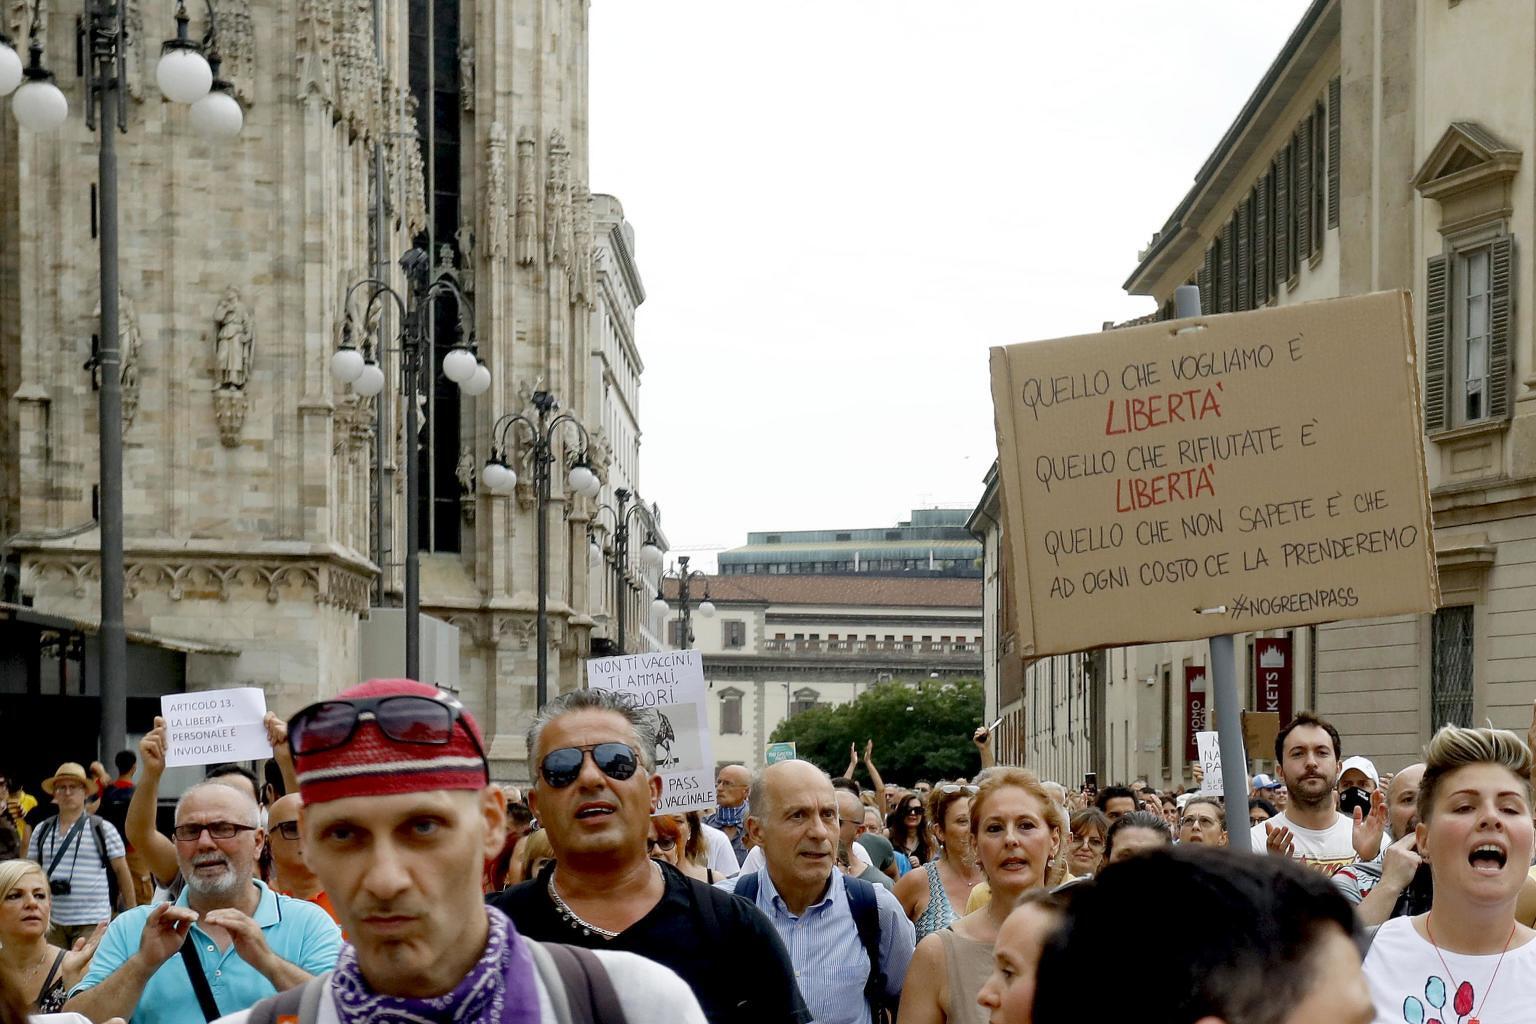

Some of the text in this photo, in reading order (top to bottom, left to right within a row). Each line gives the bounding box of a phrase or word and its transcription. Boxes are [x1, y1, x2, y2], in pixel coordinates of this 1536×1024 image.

[1022, 369, 1110, 421] QUELLO
[1121, 361, 1161, 392] CHE
[1171, 343, 1274, 381] VOGLIAMO
[1035, 449, 1116, 493] QUELLO
[1126, 445, 1168, 473] CHE
[1177, 426, 1284, 465] RIFIUTATE
[1044, 523, 1124, 567] QUELLO
[1136, 520, 1172, 546] CHE
[1182, 509, 1224, 540] NON
[1238, 498, 1315, 533] SAPETE
[1354, 489, 1389, 514] CHE
[1049, 525, 1418, 600] AD OGNI COSTO CE LA PRENDEREMO
[1230, 586, 1359, 619] #NOGREENPASS
[594, 659, 622, 674] NON
[607, 675, 621, 688] TI
[1265, 672, 1279, 711] KETS
[170, 699, 234, 713] ARTICOLO 13.
[171, 719, 183, 728] LA
[172, 729, 230, 742] PERSONALE
[174, 744, 235, 756] INVIOLABILE.
[669, 776, 699, 792] PASS
